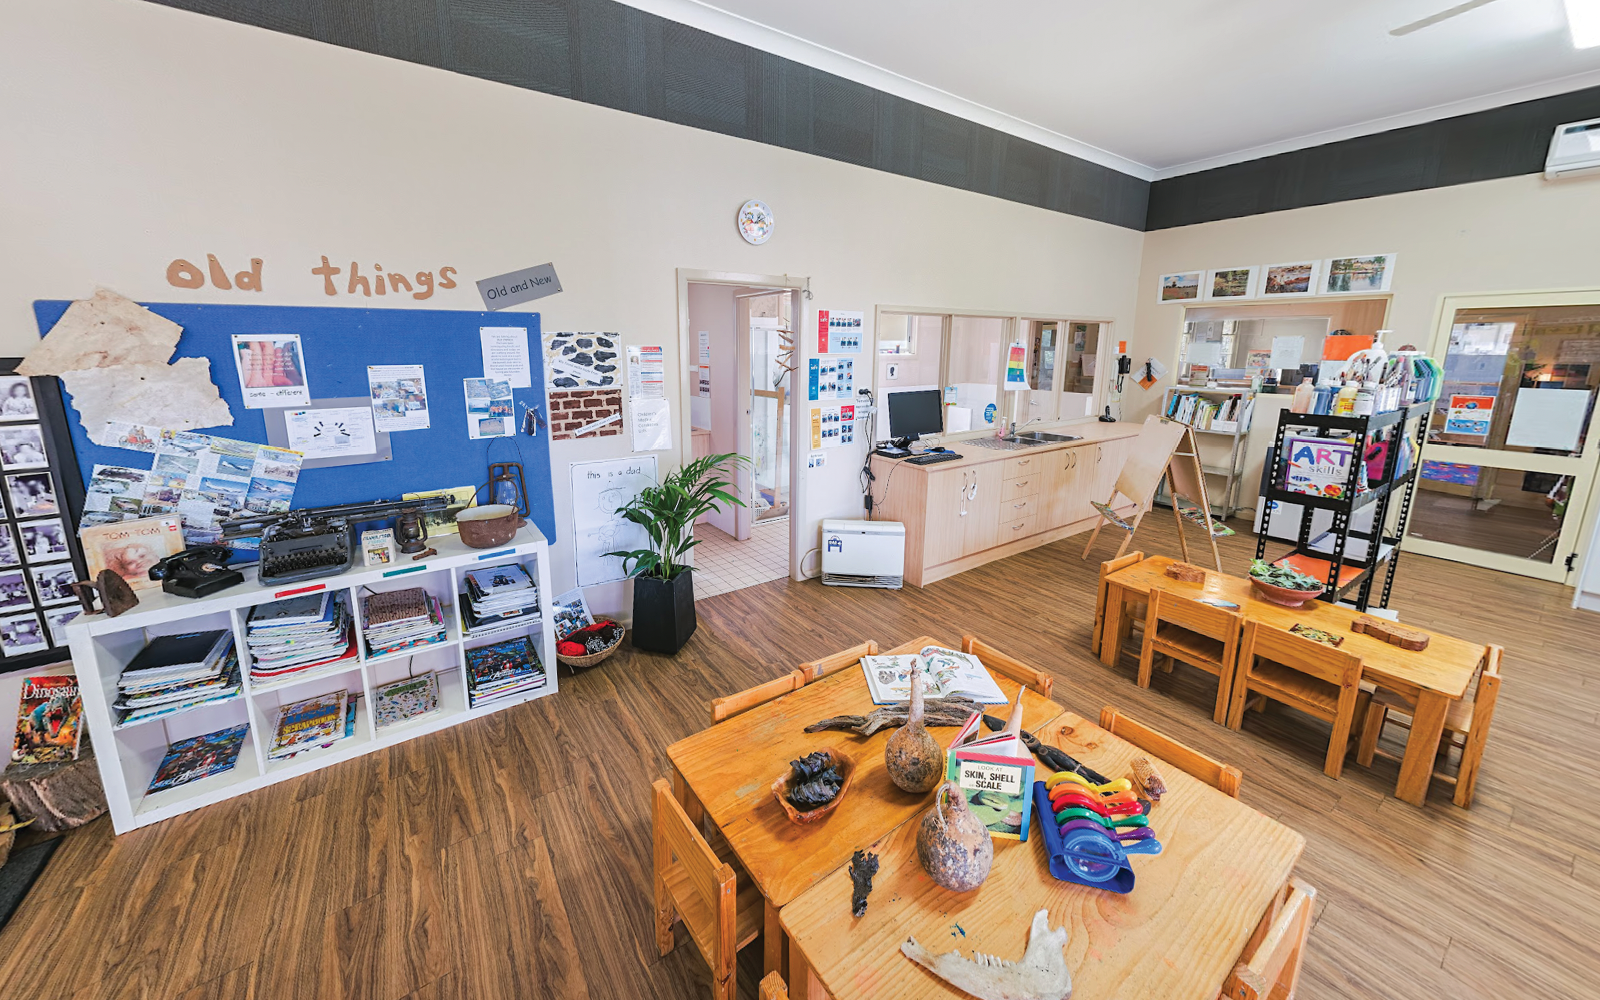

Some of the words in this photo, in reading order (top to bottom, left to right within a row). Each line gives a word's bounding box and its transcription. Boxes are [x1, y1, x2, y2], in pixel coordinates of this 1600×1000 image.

[311, 255, 457, 300] things
[487, 285, 508, 300] Old
[510, 280, 529, 294] and
[529, 276, 552, 288] New
[1293, 445, 1353, 467] ART
[587, 470, 601, 479] this
[626, 466, 641, 475] dad
[1309, 465, 1342, 475] skills
[102, 530, 130, 541] TOM
[134, 527, 161, 537] TOM
[964, 770, 987, 780] SKIN,
[990, 773, 1015, 783] SHELL
[975, 780, 1002, 790] SCALE
